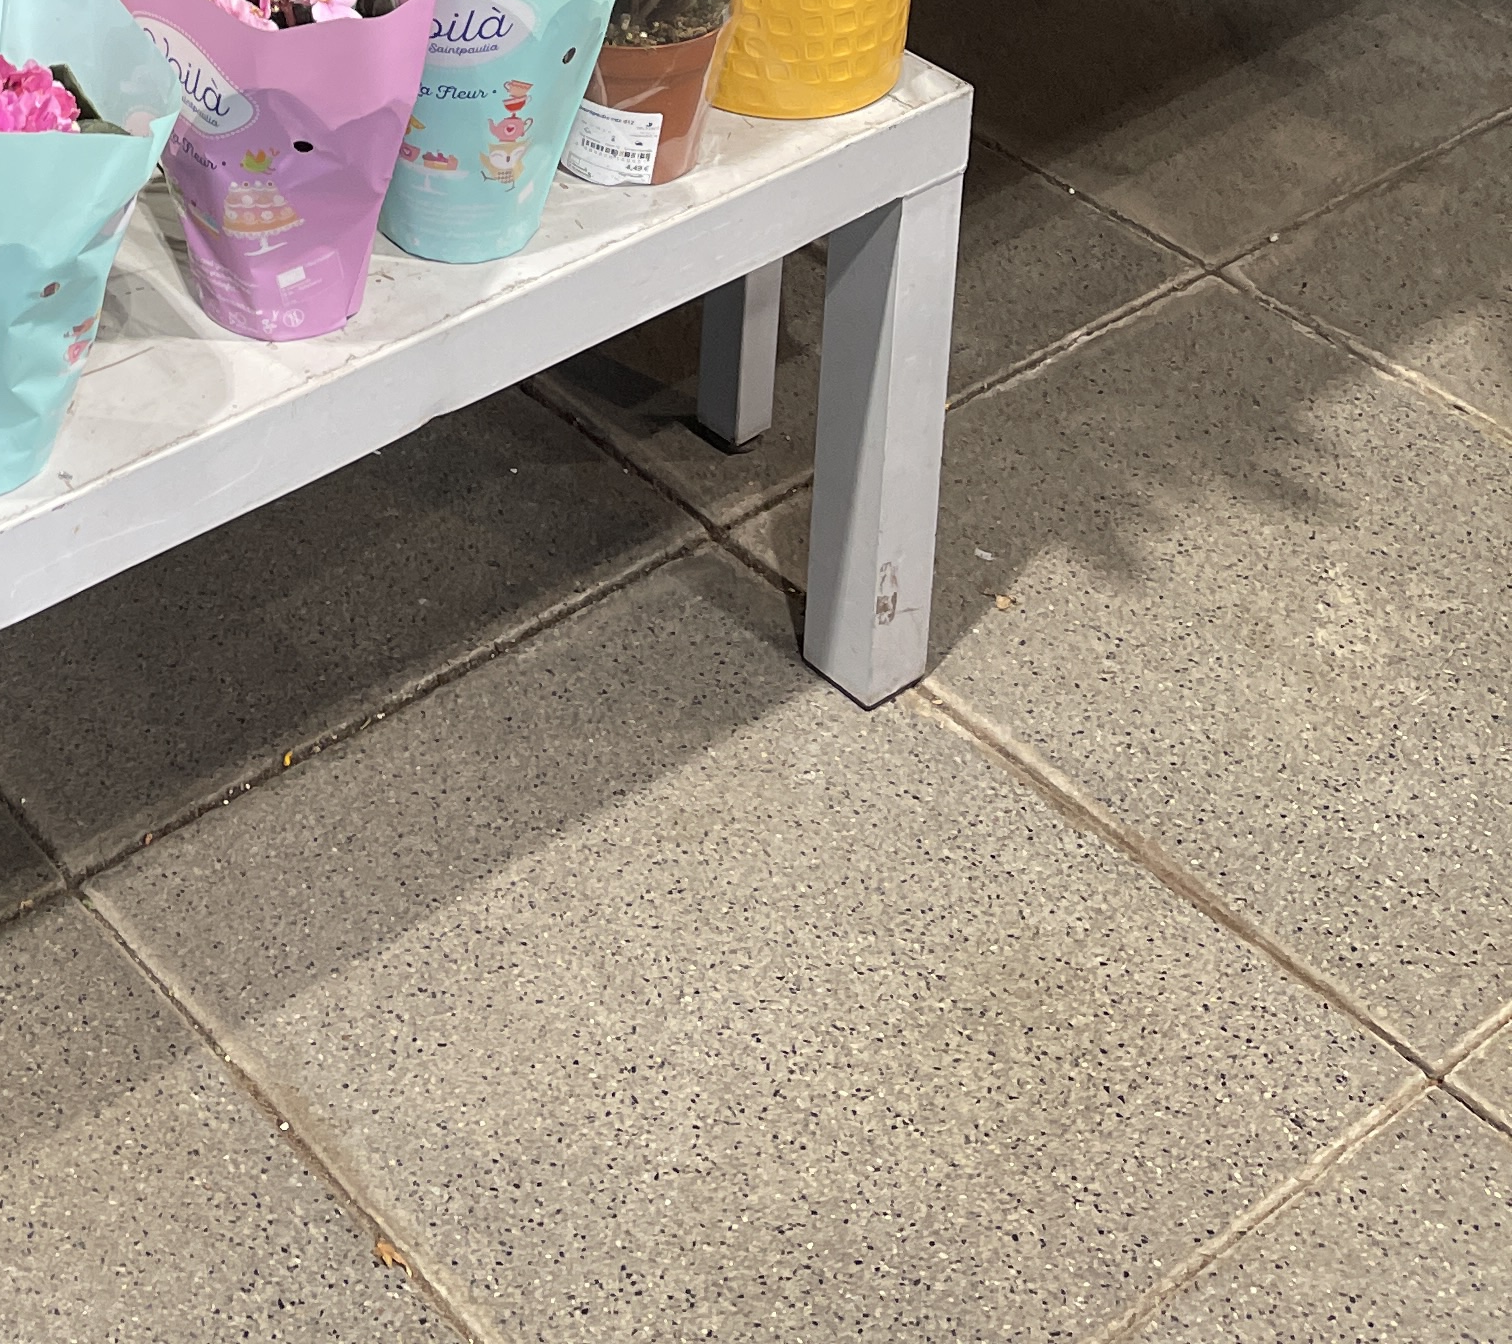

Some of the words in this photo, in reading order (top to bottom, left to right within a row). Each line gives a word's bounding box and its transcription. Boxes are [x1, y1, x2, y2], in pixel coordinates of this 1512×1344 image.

[428, 6, 514, 43] oilà
[428, 42, 499, 56] Saintpaulia
[435, 84, 488, 100] Fleur
